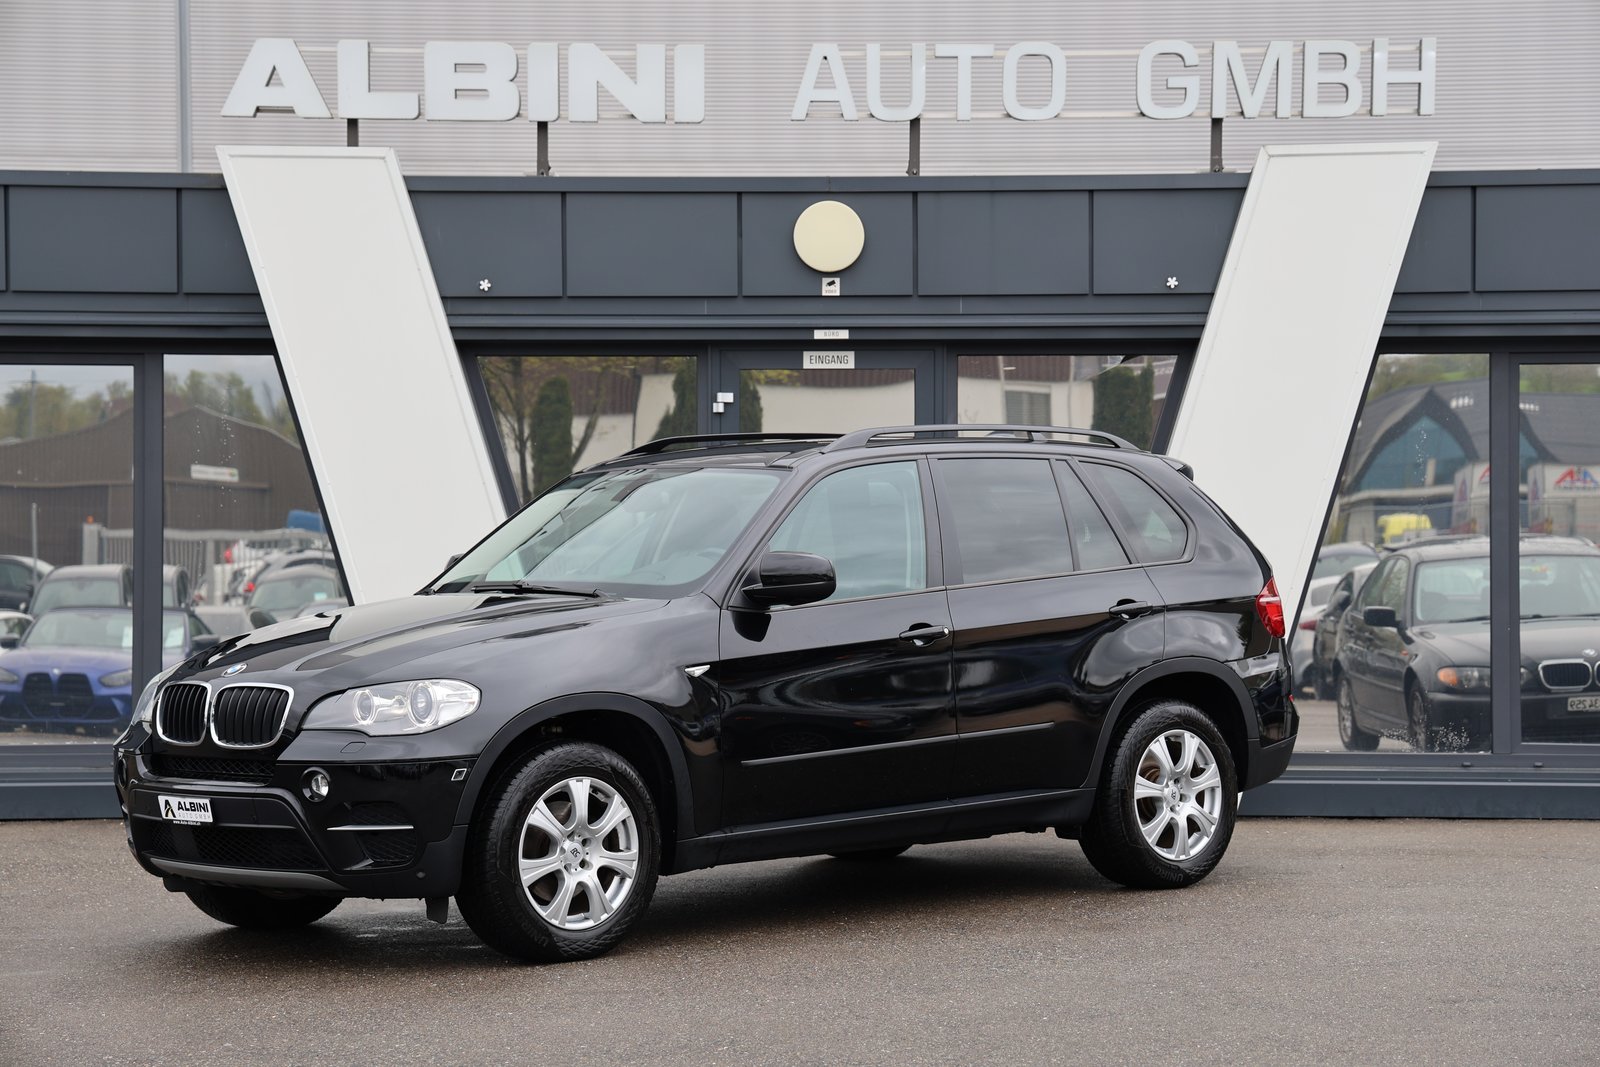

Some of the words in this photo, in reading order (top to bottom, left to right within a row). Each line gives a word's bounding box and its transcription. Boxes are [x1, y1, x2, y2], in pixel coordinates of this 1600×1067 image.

[220, 37, 705, 124] ALBINI
[790, 41, 1068, 123] AUTO
[1135, 36, 1437, 120] GMBH
[809, 354, 849, 365] EINGANG
[177, 800, 209, 813] ALBINI
